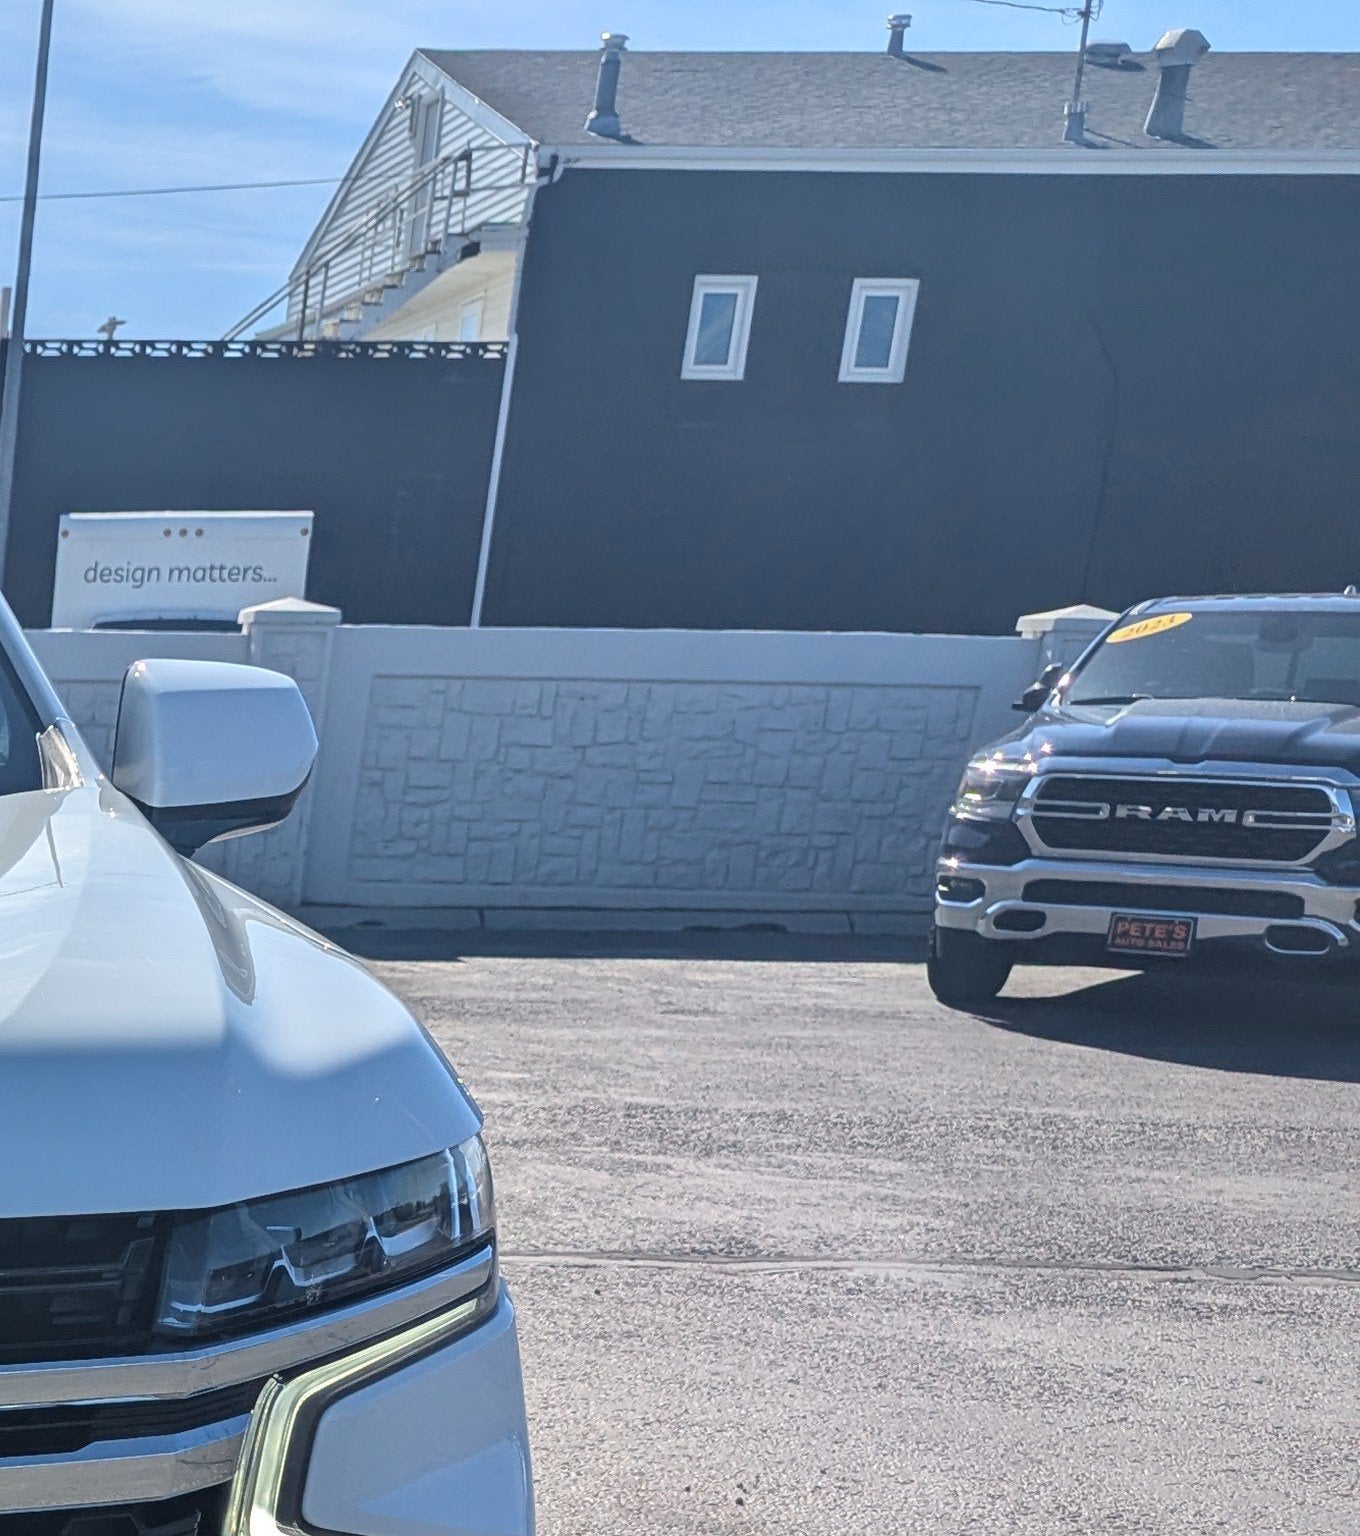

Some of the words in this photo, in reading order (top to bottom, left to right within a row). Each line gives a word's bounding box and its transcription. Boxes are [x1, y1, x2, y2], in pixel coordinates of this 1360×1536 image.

[83, 561, 160, 589] design
[167, 562, 278, 583] matters...
[1115, 804, 1237, 822] RAM
[1116, 921, 1187, 940] PETE'S
